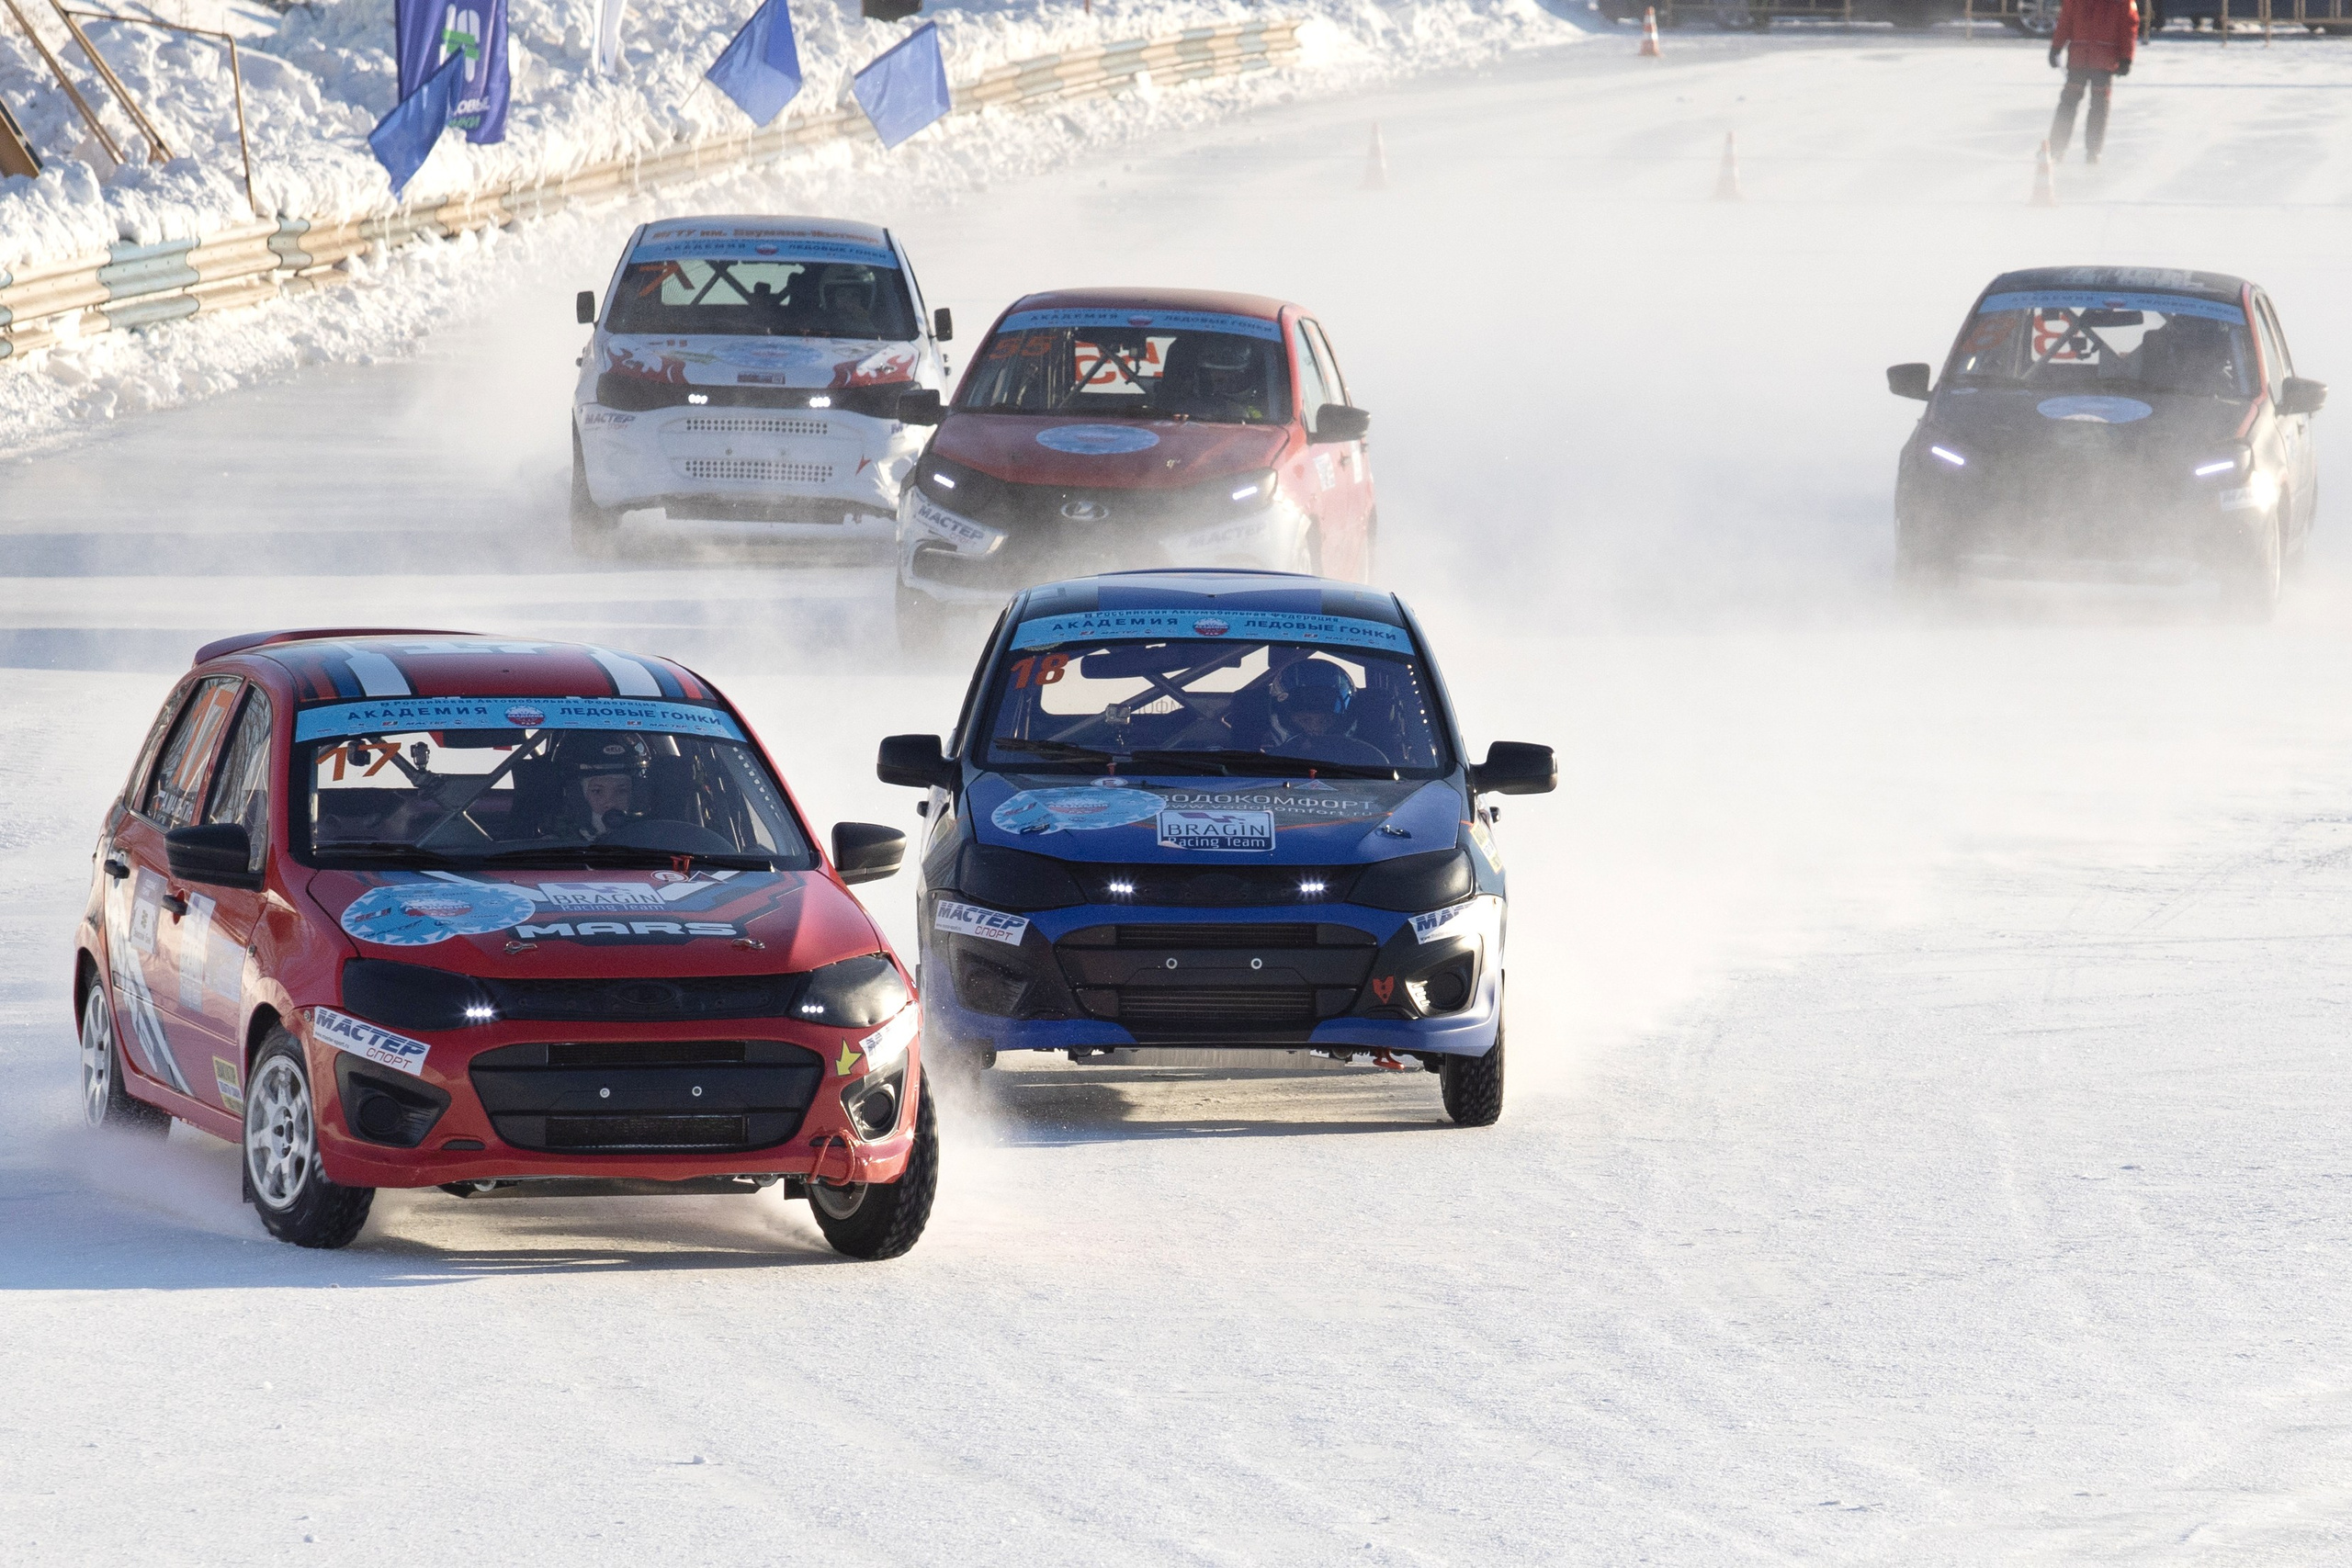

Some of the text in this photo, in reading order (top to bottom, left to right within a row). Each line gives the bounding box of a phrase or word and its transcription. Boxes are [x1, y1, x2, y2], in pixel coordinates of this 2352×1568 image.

[989, 335, 1057, 360] 55
[919, 504, 985, 539] МАСТЕР
[1096, 610, 1167, 618] Российская
[1271, 613, 1339, 623] Федерация
[1052, 618, 1396, 641] АКАДЕМИЯ ЛЕДОВЫЕ ГОНКИ
[1011, 653, 1069, 690] 18
[347, 706, 721, 726] АКАДЕМИЯ ЛЕДОВЫЕ ГОНКИ
[315, 742, 401, 782] 17
[1168, 822, 1264, 836] BRAGIN
[1169, 837, 1265, 848] Racing Team
[552, 894, 662, 904] BRAGIN
[560, 903, 665, 912] Racing Team
[937, 901, 1026, 931] МАСТЕР
[514, 921, 737, 938] MARS
[974, 925, 1013, 941] СПОРТ
[315, 1009, 426, 1056] МАСТЕР
[366, 1047, 413, 1068] СПОРТ
